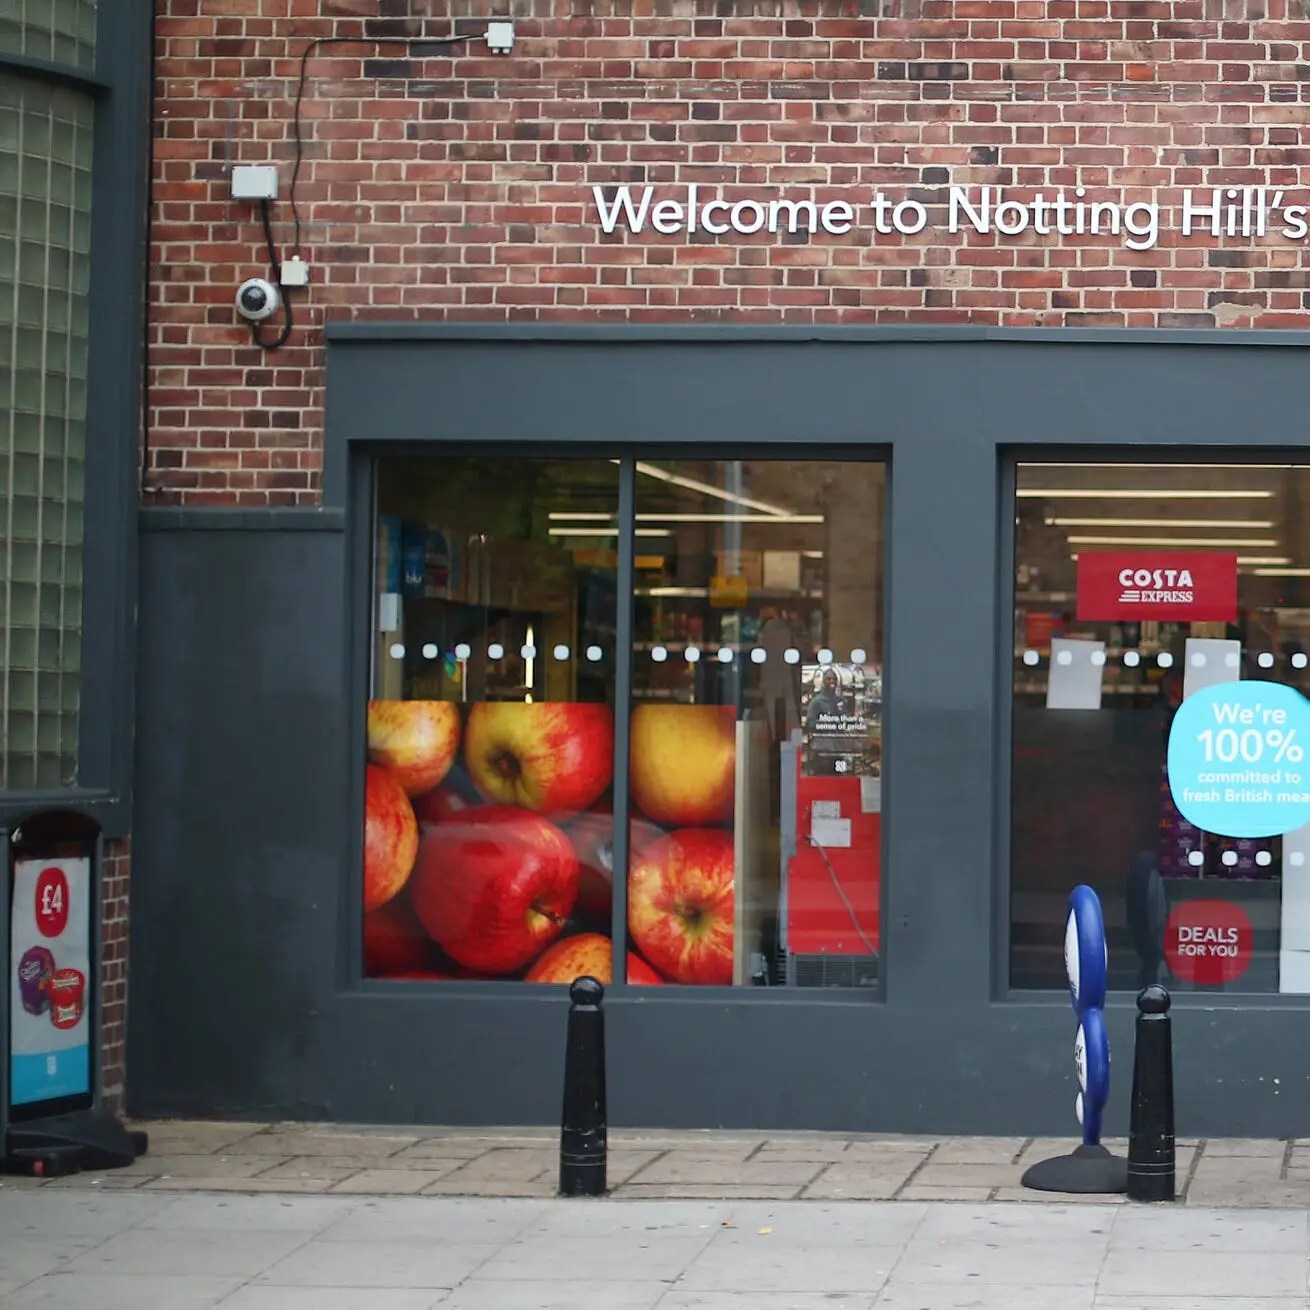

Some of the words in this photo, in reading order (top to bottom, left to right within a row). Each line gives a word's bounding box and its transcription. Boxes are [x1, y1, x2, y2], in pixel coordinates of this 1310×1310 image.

[592, 184, 853, 234] Welcome
[871, 192, 927, 235] to
[948, 186, 1158, 250] Notting
[1182, 187, 1308, 240] Hill's
[1118, 568, 1194, 589] COSTA
[1140, 590, 1194, 604] EXPRESS
[819, 714, 839, 722] More
[1212, 703, 1288, 725] We're
[1196, 728, 1305, 764] 100%
[1197, 769, 1281, 785] committed
[1284, 770, 1302, 785] to
[1182, 787, 1220, 803] fresh
[1224, 787, 1273, 804] British
[41, 884, 64, 916] £4
[1177, 926, 1239, 944] DEALS
[1177, 944, 1207, 958] FOR
[1208, 944, 1239, 958] YOU
